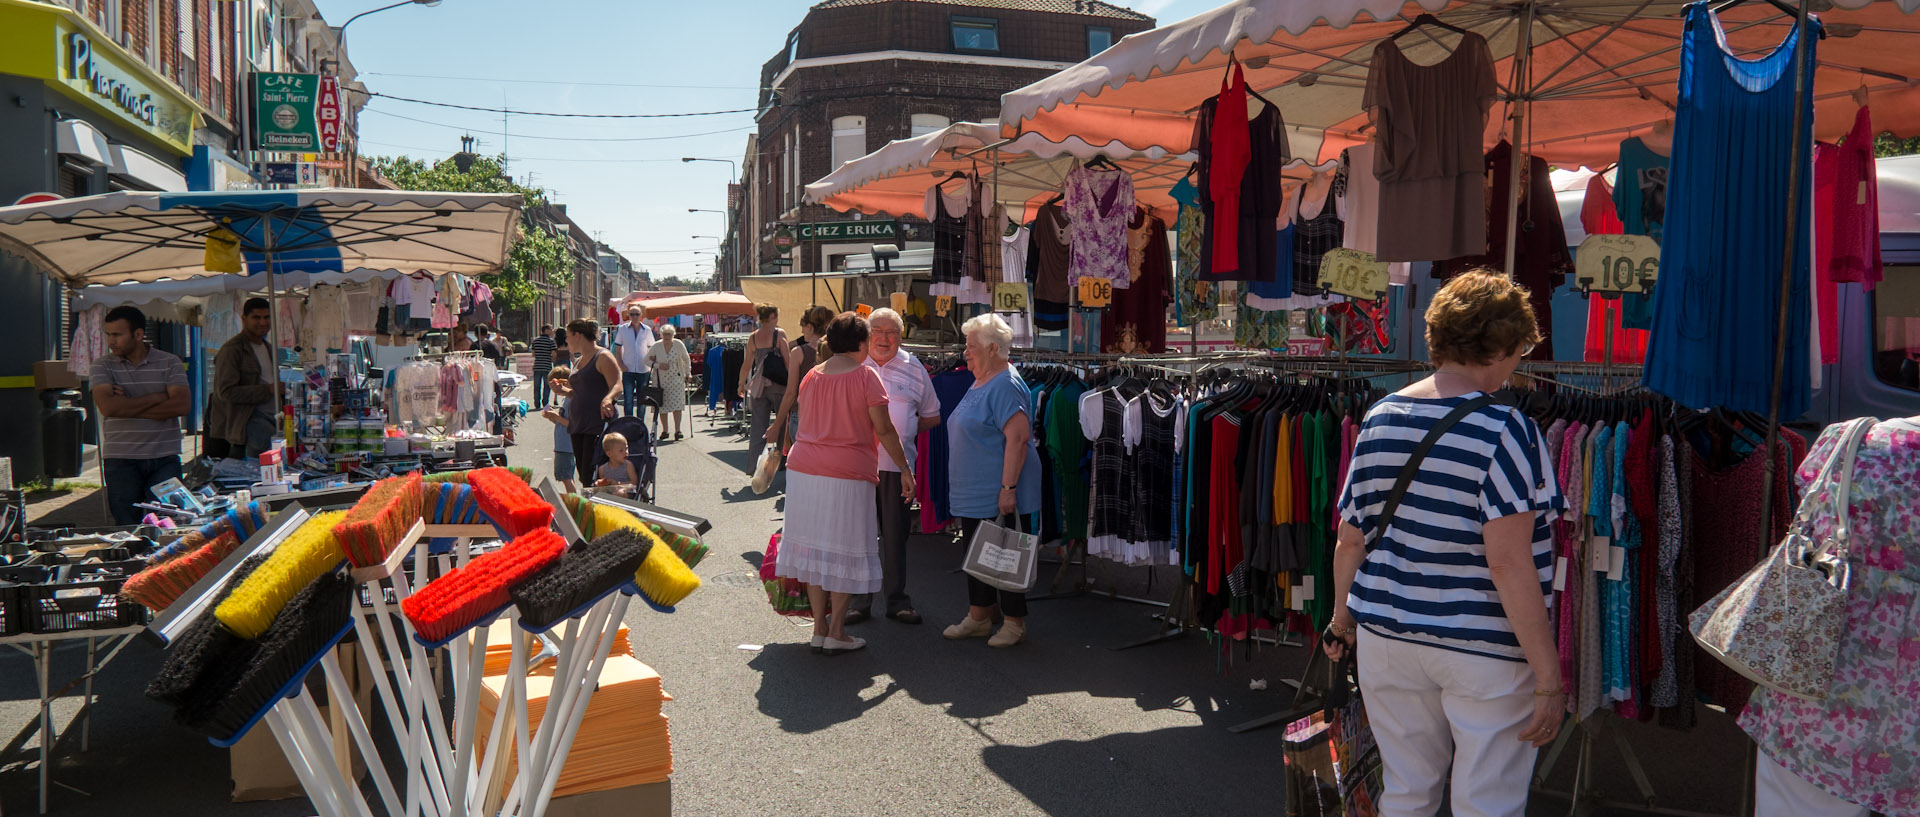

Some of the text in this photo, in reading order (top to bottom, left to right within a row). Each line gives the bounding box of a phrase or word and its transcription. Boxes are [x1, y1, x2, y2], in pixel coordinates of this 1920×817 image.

[264, 75, 303, 88] CAFE
[321, 79, 337, 148] TABAC
[268, 135, 308, 144] Heineken
[802, 224, 894, 237] CHEZ ERIKA
[1333, 263, 1377, 295] 10€
[1602, 255, 1660, 290] 10€
[1087, 281, 1112, 300] 10€
[997, 292, 1023, 308] 10€
